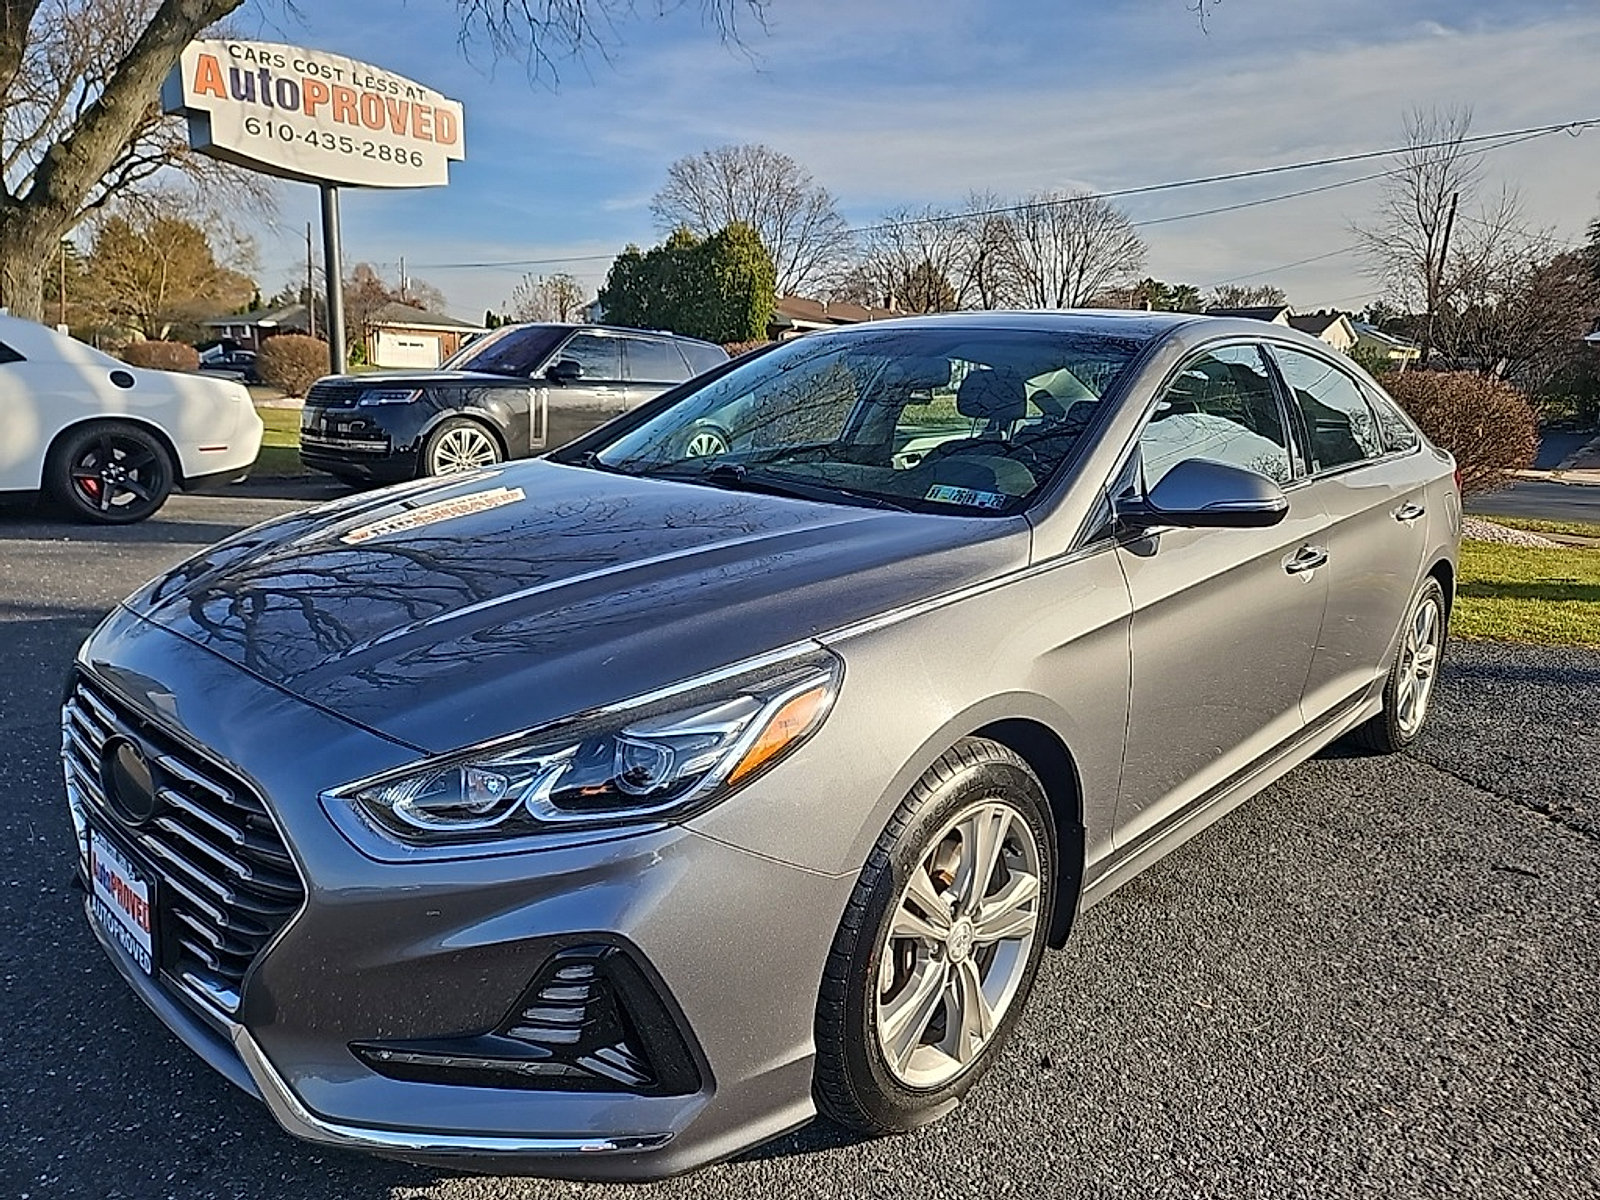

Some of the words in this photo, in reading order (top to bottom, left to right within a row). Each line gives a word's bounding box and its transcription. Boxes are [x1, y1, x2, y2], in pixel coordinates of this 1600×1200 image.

[193, 53, 457, 145] AutoPROVED
[228, 44, 286, 69] CARS
[293, 59, 344, 81] COST
[352, 72, 398, 95] LESS
[406, 86, 426, 101] AT
[245, 116, 423, 167] 610-435-2886
